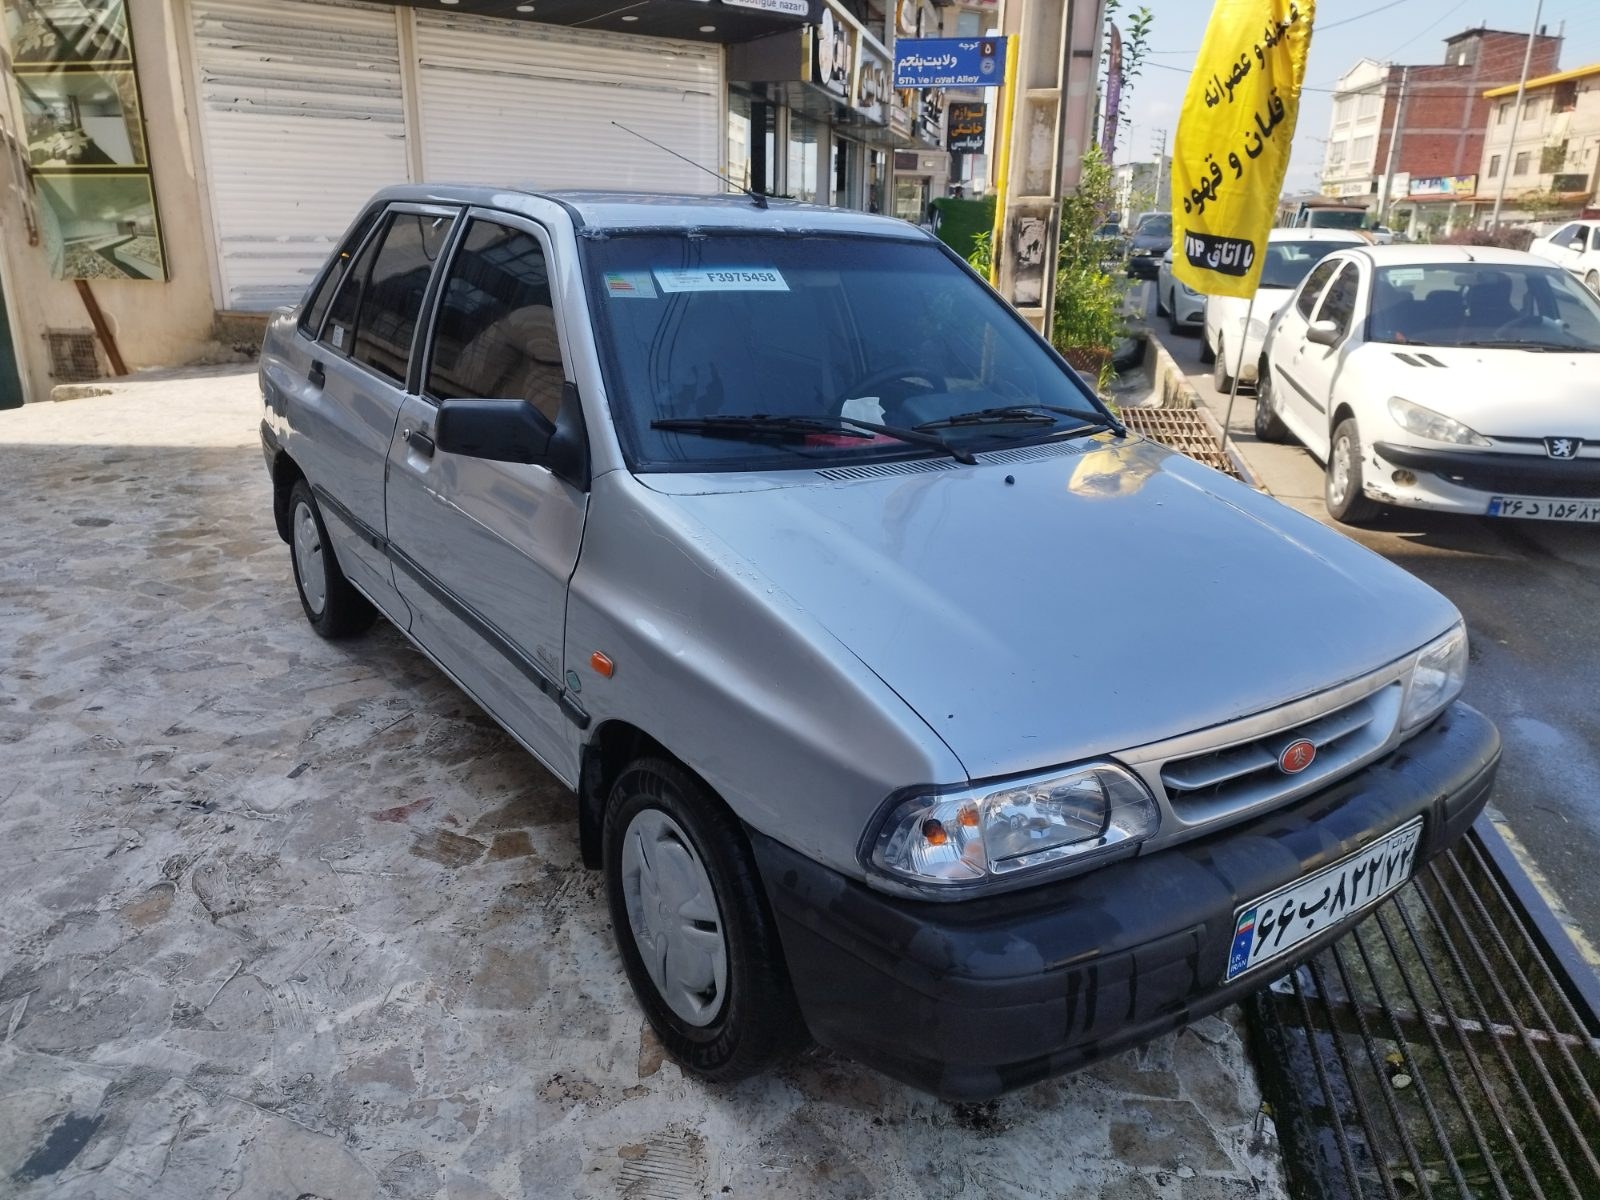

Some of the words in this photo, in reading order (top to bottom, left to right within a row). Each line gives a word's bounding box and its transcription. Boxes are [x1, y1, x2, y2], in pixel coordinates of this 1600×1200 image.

[959, 41, 980, 51] کوچه
[984, 43, 992, 54] ۵
[1254, 44, 1265, 70] و
[956, 75, 980, 84] Alley
[1204, 52, 1251, 109] عصرانه
[952, 105, 985, 121] لوازم
[951, 122, 984, 137] خانگی
[1244, 87, 1286, 160] قلیان
[1228, 152, 1243, 180] و
[1183, 153, 1223, 216] قهوه
[1207, 242, 1242, 268] اتاق
[706, 272, 777, 283] F3975458
[1230, 959, 1247, 973] IRAN
